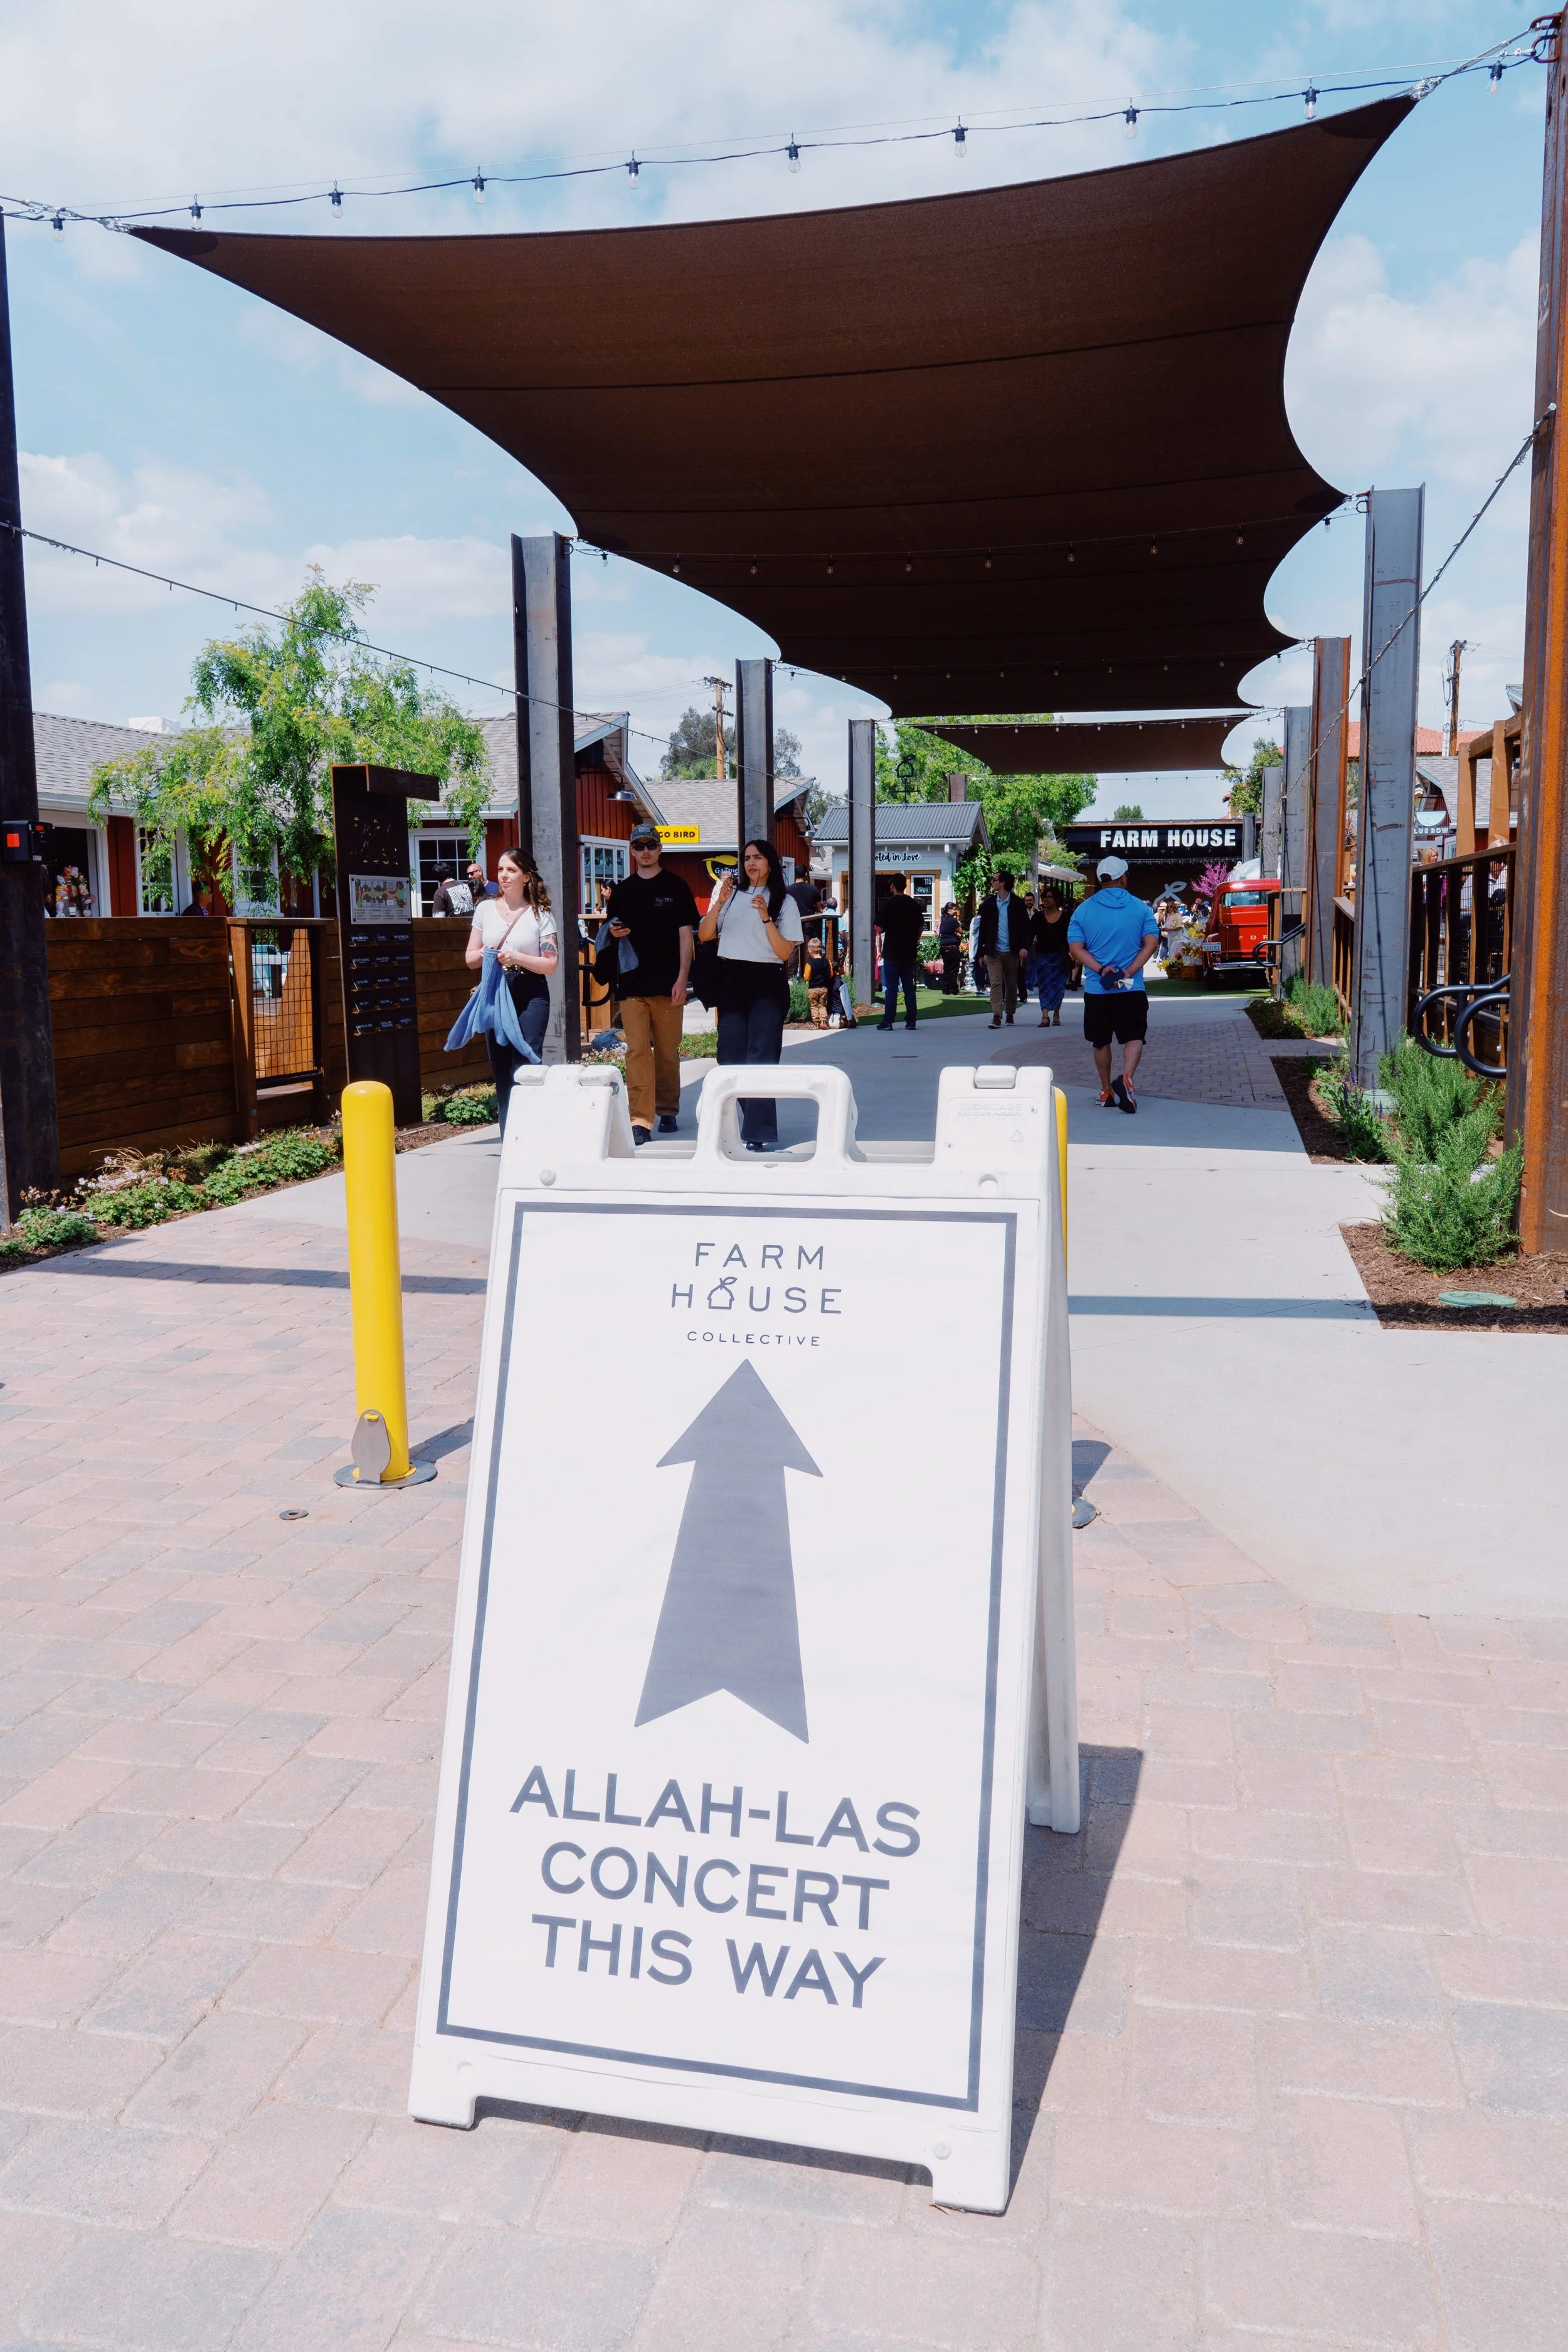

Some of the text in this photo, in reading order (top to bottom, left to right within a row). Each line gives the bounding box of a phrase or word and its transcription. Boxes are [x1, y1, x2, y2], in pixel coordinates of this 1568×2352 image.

[1100, 829, 1236, 847] FARM HOUSE
[875, 852, 920, 862] oted in Love
[695, 1242, 824, 1270] FARM
[687, 1331, 820, 1347] COLLECTIVE
[509, 1764, 921, 1858] ALLAH-LAS
[541, 1841, 890, 1931] CONCERT
[532, 1914, 887, 2009] THIS WAY
